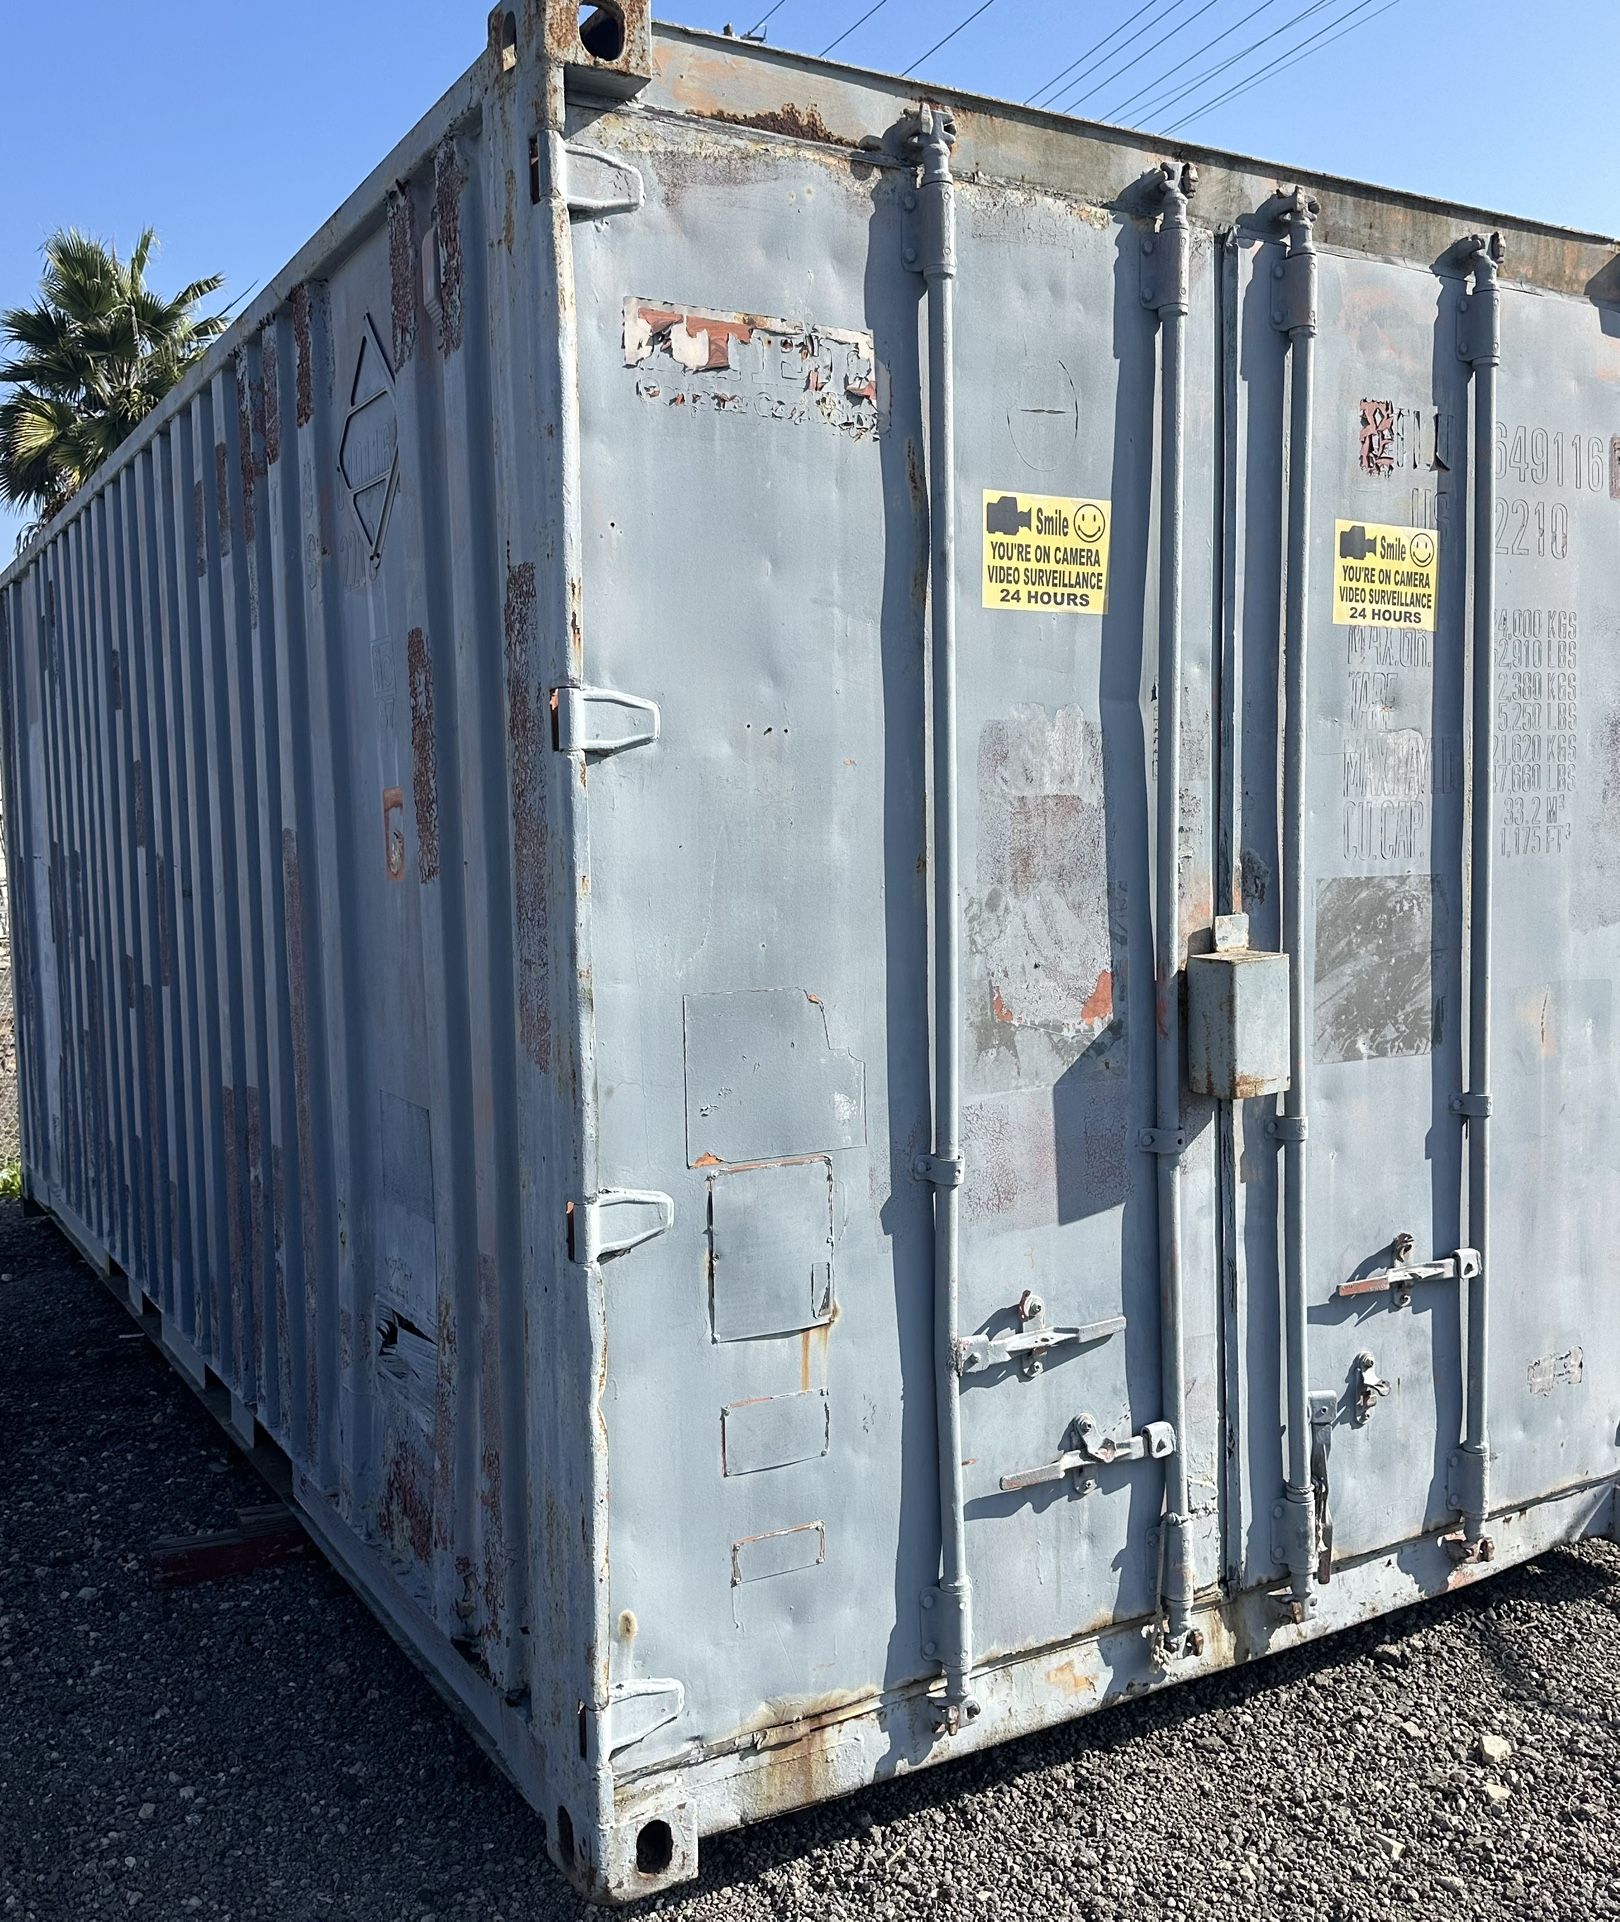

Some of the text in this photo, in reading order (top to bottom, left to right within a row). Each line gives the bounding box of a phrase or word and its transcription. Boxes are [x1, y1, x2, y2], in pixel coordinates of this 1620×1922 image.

[1036, 507, 1068, 537] Smile
[990, 541, 1101, 567] YOU'RE ON CAMERA
[1380, 535, 1406, 562] Smile
[987, 565, 1103, 590] VIDEO SURVEILLANCE
[1342, 565, 1430, 589] YOU'RE ON CAMERA
[1000, 588, 1090, 607] 24 HOURS
[1339, 585, 1432, 609] VIDEO SURVEILLANCE
[1349, 607, 1422, 624] 24 HOURS
[1494, 608, 1577, 640] 4,000 KGS
[1547, 639, 1577, 669] LBS
[1498, 671, 1577, 702] 2,380 KGS
[1498, 702, 1577, 732] 5,250 LBS
[1547, 734, 1577, 763] KGS
[1546, 764, 1576, 792] LBS
[1504, 796, 1541, 826] 33.2
[1500, 826, 1541, 858] 1,175
